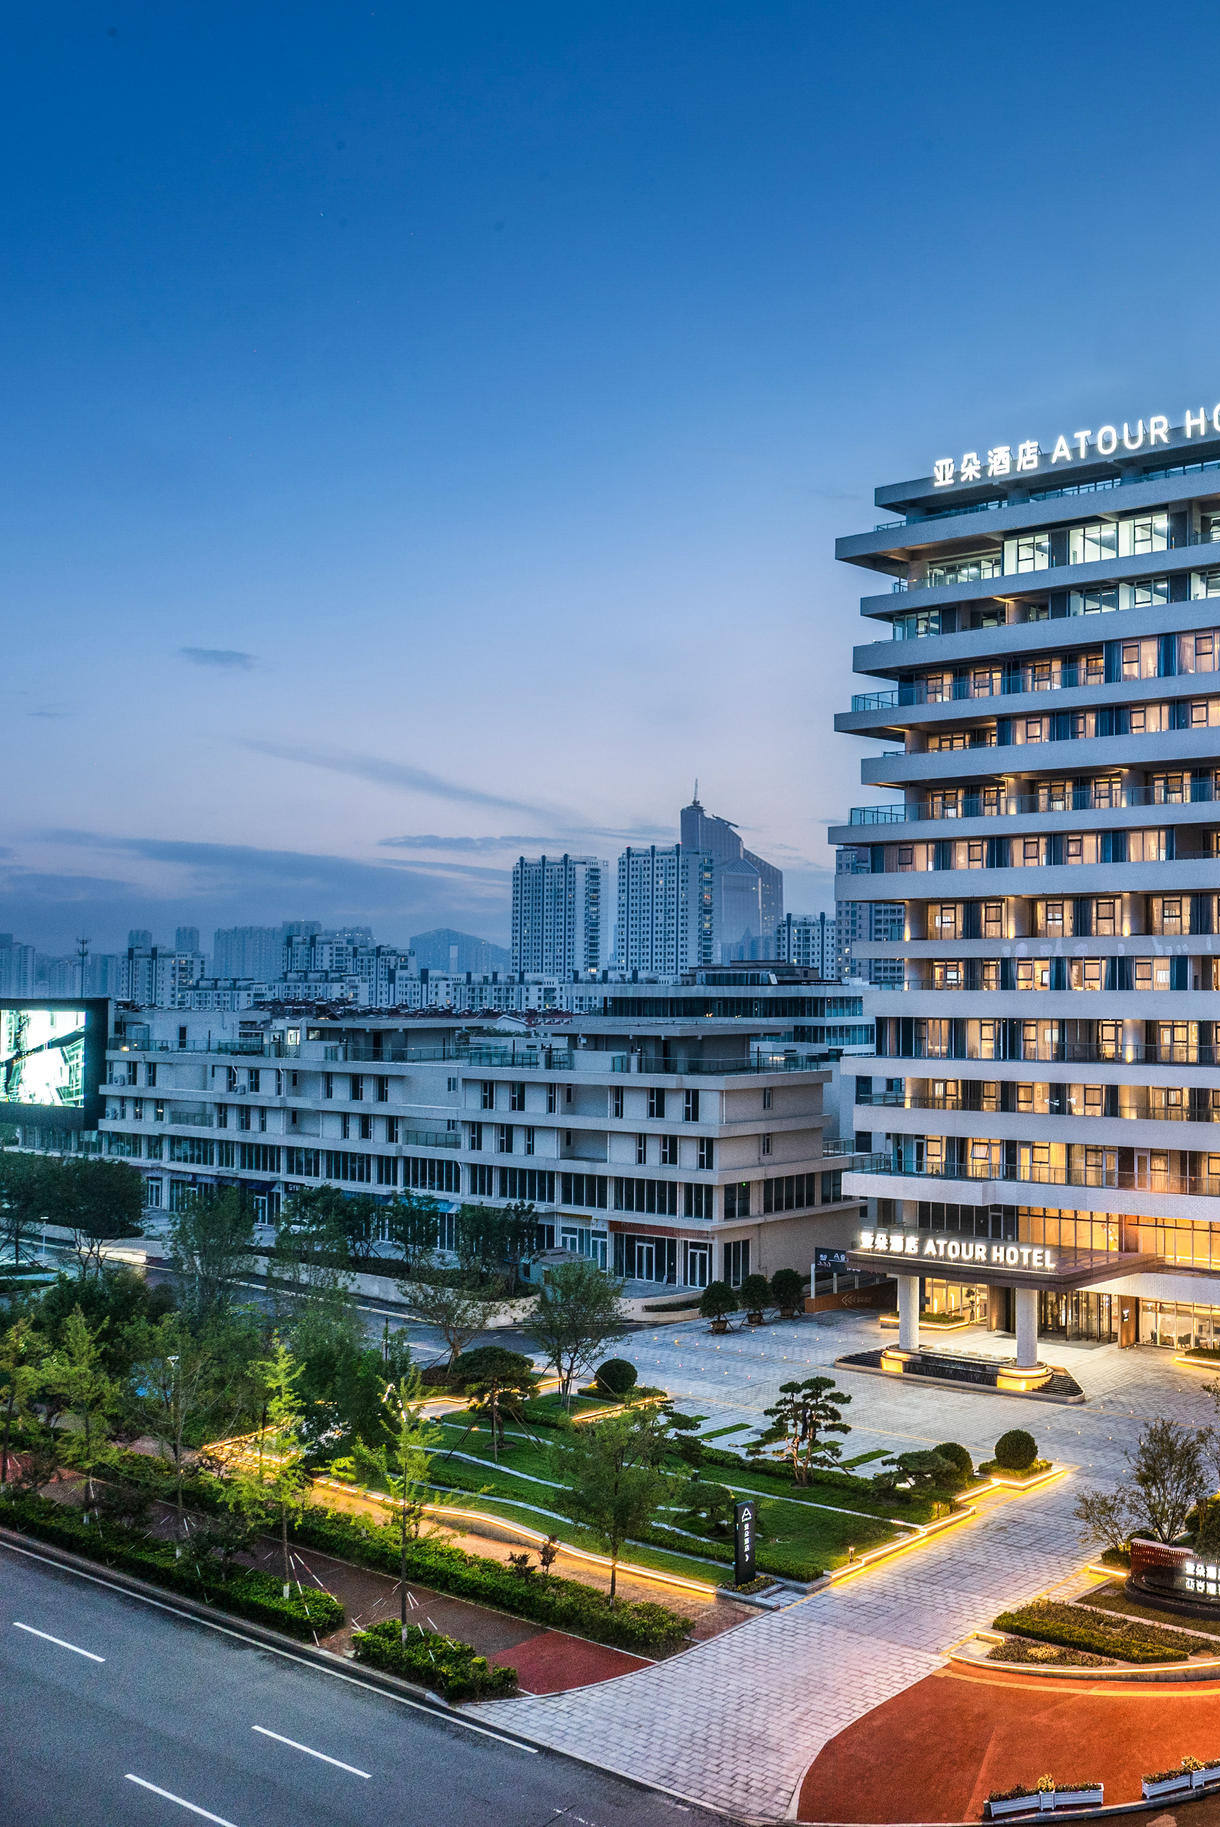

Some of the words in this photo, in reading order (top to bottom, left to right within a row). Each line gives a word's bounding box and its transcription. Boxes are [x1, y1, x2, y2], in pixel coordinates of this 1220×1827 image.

[933, 439, 1040, 487] 亚朵酒店
[1051, 415, 1169, 463] ATOUR
[924, 1239, 987, 1260] ATOUR
[992, 1245, 1056, 1268] HOTEL
